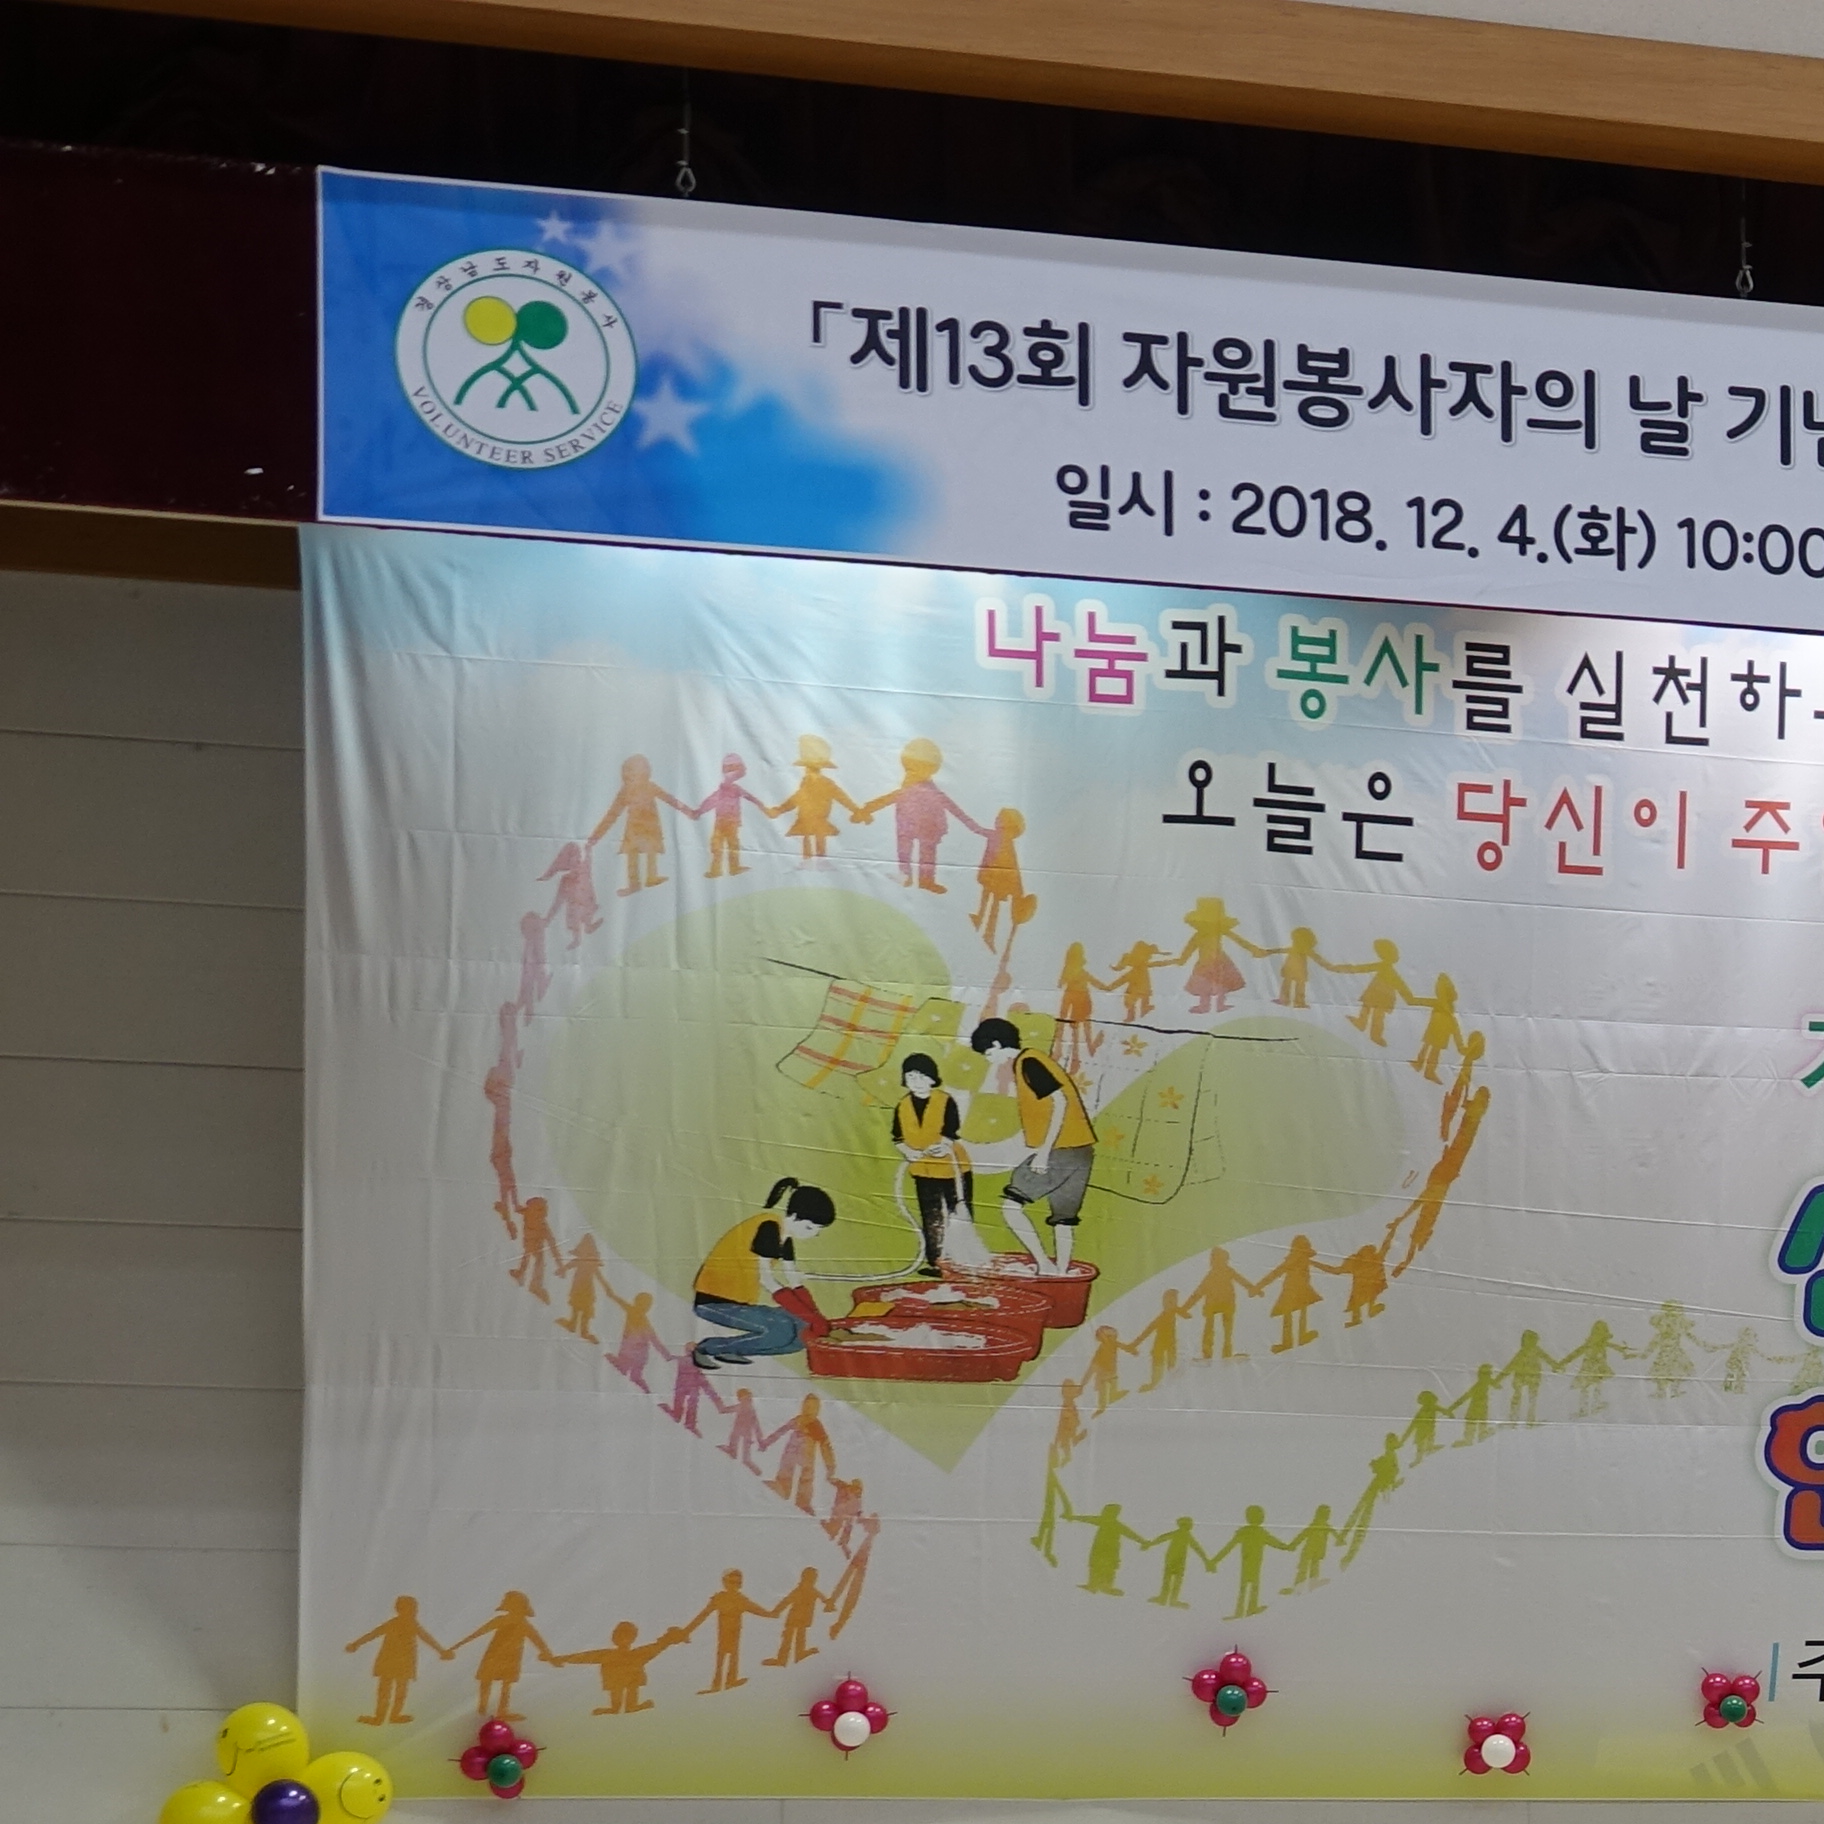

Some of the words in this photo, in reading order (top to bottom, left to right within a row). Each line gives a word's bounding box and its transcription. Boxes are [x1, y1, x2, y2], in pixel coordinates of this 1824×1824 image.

[412, 386, 534, 464] VOLUNTEER
[544, 400, 623, 463] SERVICE
[1122, 331, 1595, 450] 자원봉사자의
[1628, 374, 1703, 457] 날
[987, 604, 1243, 705] 나눔과
[1276, 625, 1523, 733] 봉사를
[1162, 759, 1414, 863] 오늘은
[1456, 779, 1687, 876] 당신이
